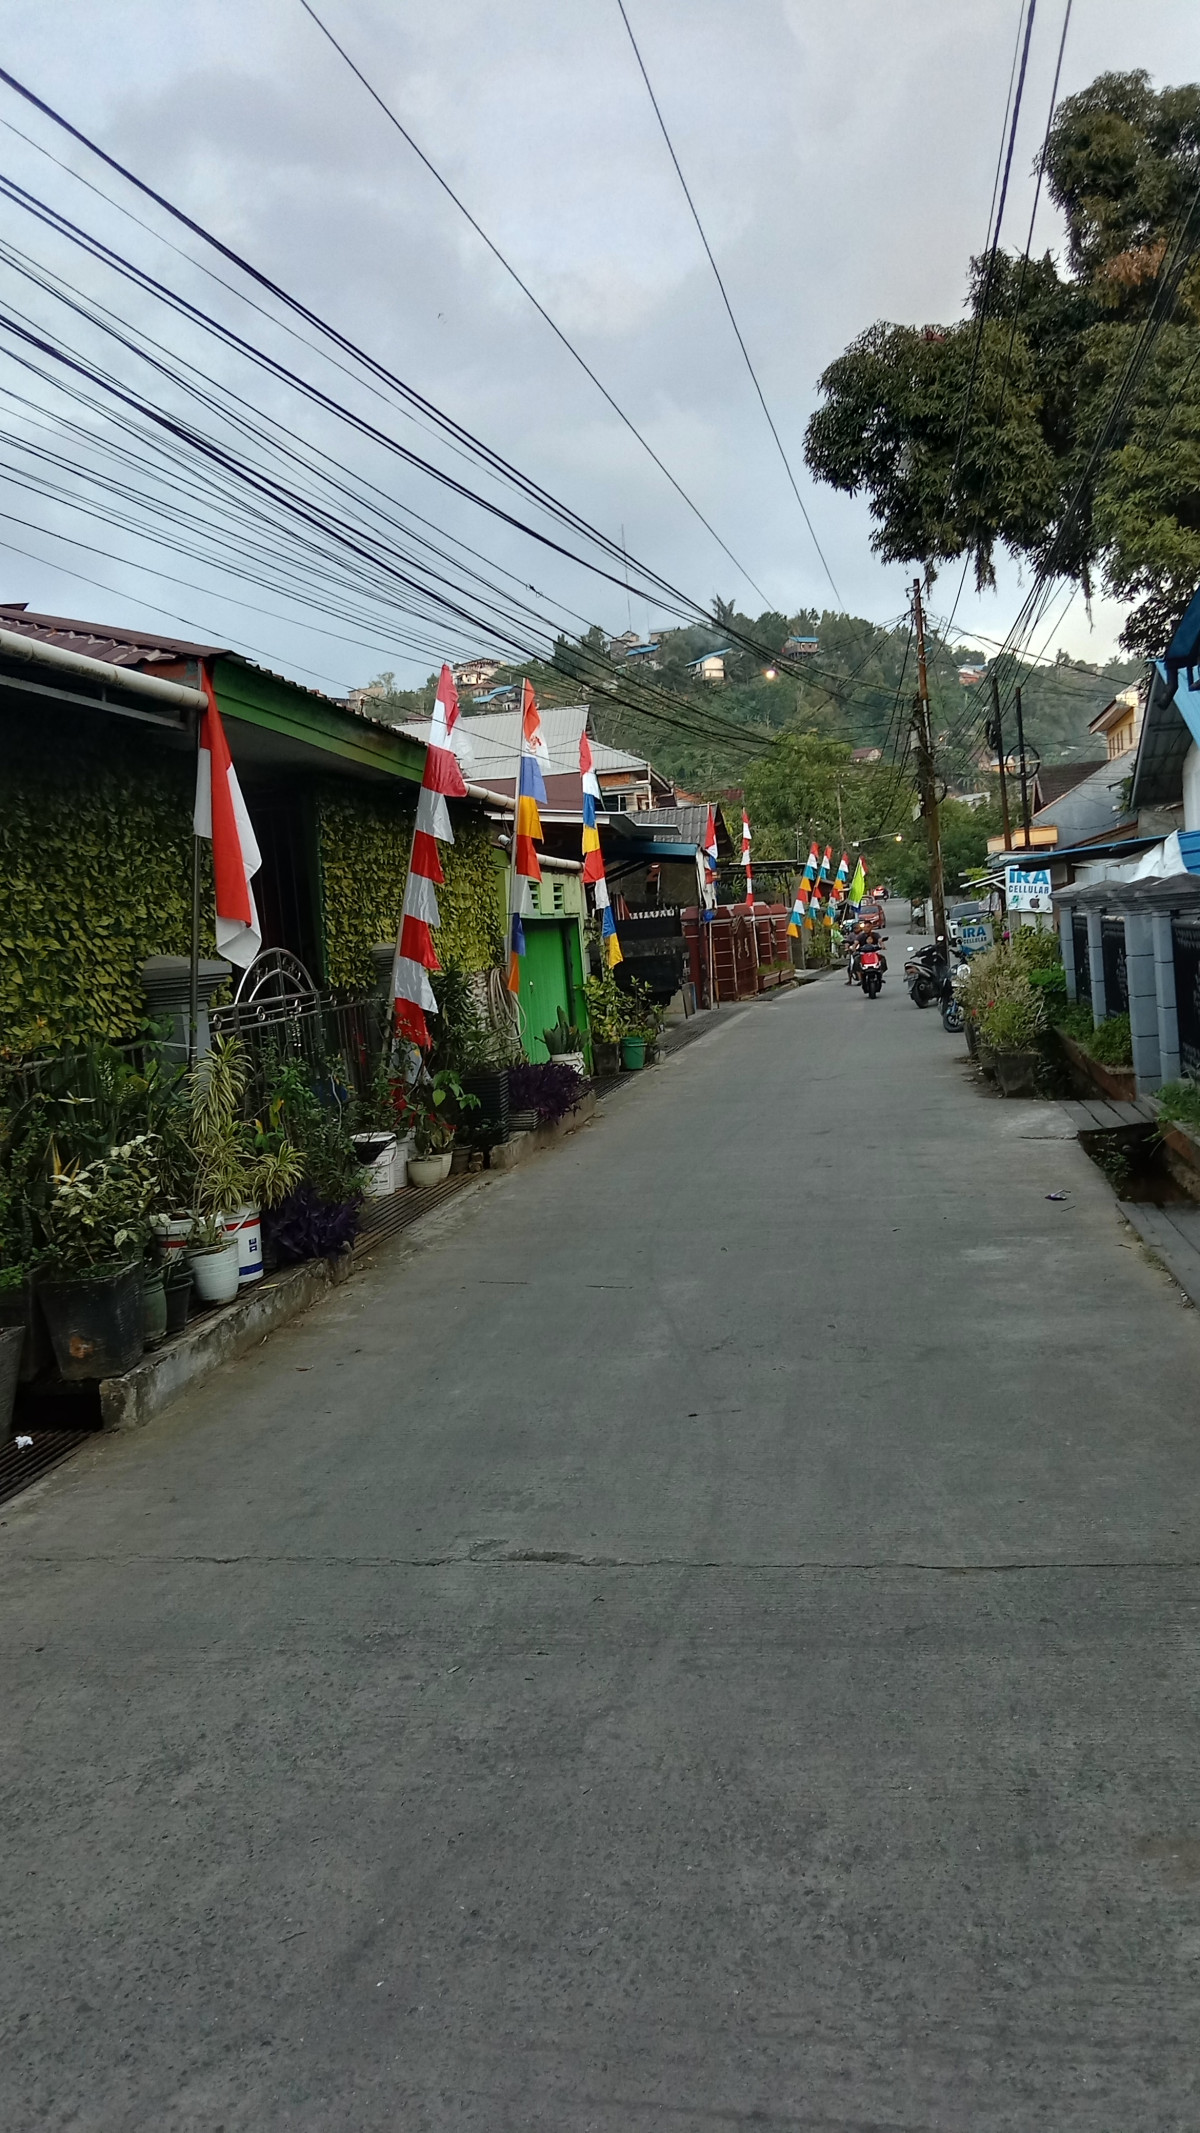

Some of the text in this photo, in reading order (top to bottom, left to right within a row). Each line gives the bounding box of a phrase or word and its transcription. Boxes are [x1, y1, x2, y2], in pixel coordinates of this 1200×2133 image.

[1009, 870, 1049, 884] IRA
[1008, 885, 1050, 894] CELLULAR
[963, 926, 986, 938] IRA
